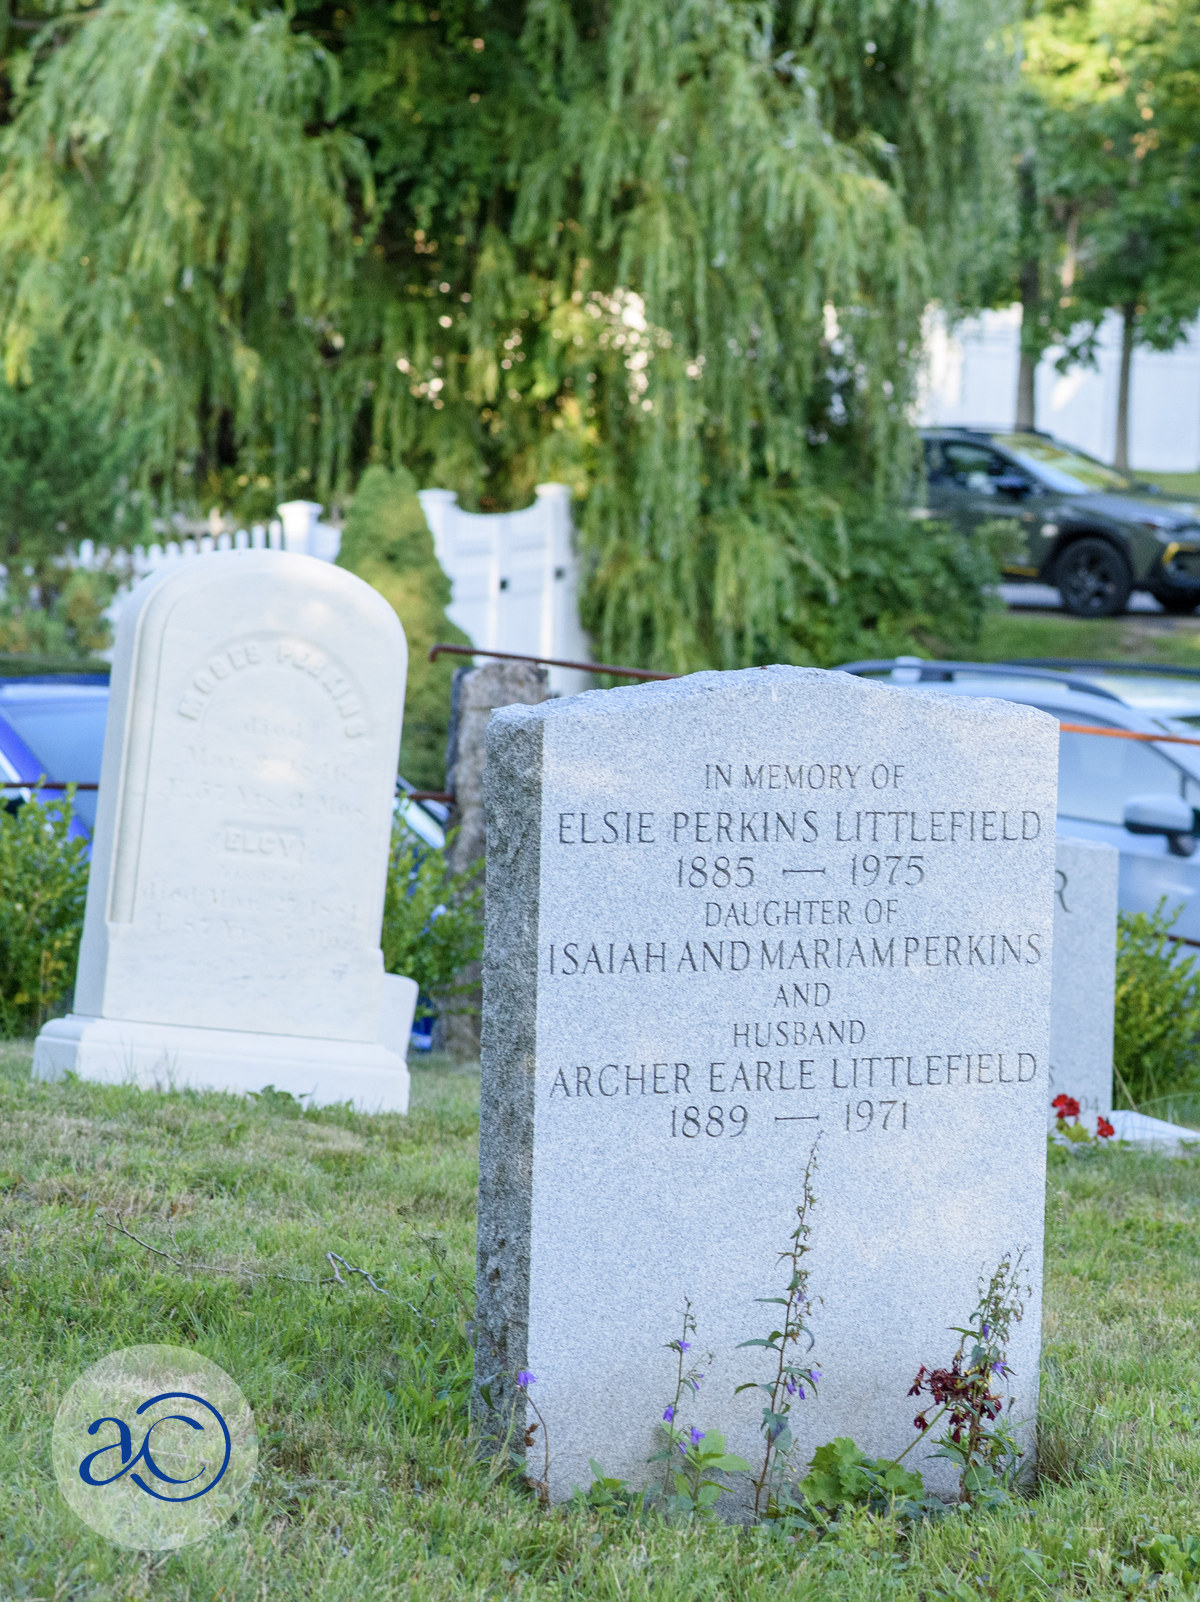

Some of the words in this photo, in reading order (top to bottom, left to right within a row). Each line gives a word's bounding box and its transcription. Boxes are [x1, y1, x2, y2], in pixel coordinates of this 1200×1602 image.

[177, 644, 263, 722] MOSES
[704, 764, 732, 789] IN
[744, 764, 858, 789] MEMORY
[871, 763, 905, 789] OF
[558, 812, 655, 845] ELSIE
[672, 810, 818, 843] PERKINS
[835, 810, 1041, 842] LITTLEFIELD
[676, 856, 755, 889] 1885
[850, 855, 925, 887] 1975
[705, 900, 852, 928] DAUGHTER
[864, 899, 900, 924] OF
[549, 941, 666, 976] ISAIAH
[678, 940, 751, 972] AND
[760, 936, 895, 971] MARIAM
[904, 933, 1042, 968] PERKINS
[774, 983, 831, 1008] AND
[732, 1020, 866, 1048] HUSBAND
[550, 1062, 692, 1098] ARCHER
[708, 1059, 815, 1094] EARLE
[831, 1053, 1038, 1089] LITTLEFIELD
[669, 1105, 748, 1138] 1889
[844, 1100, 908, 1133] 1971
